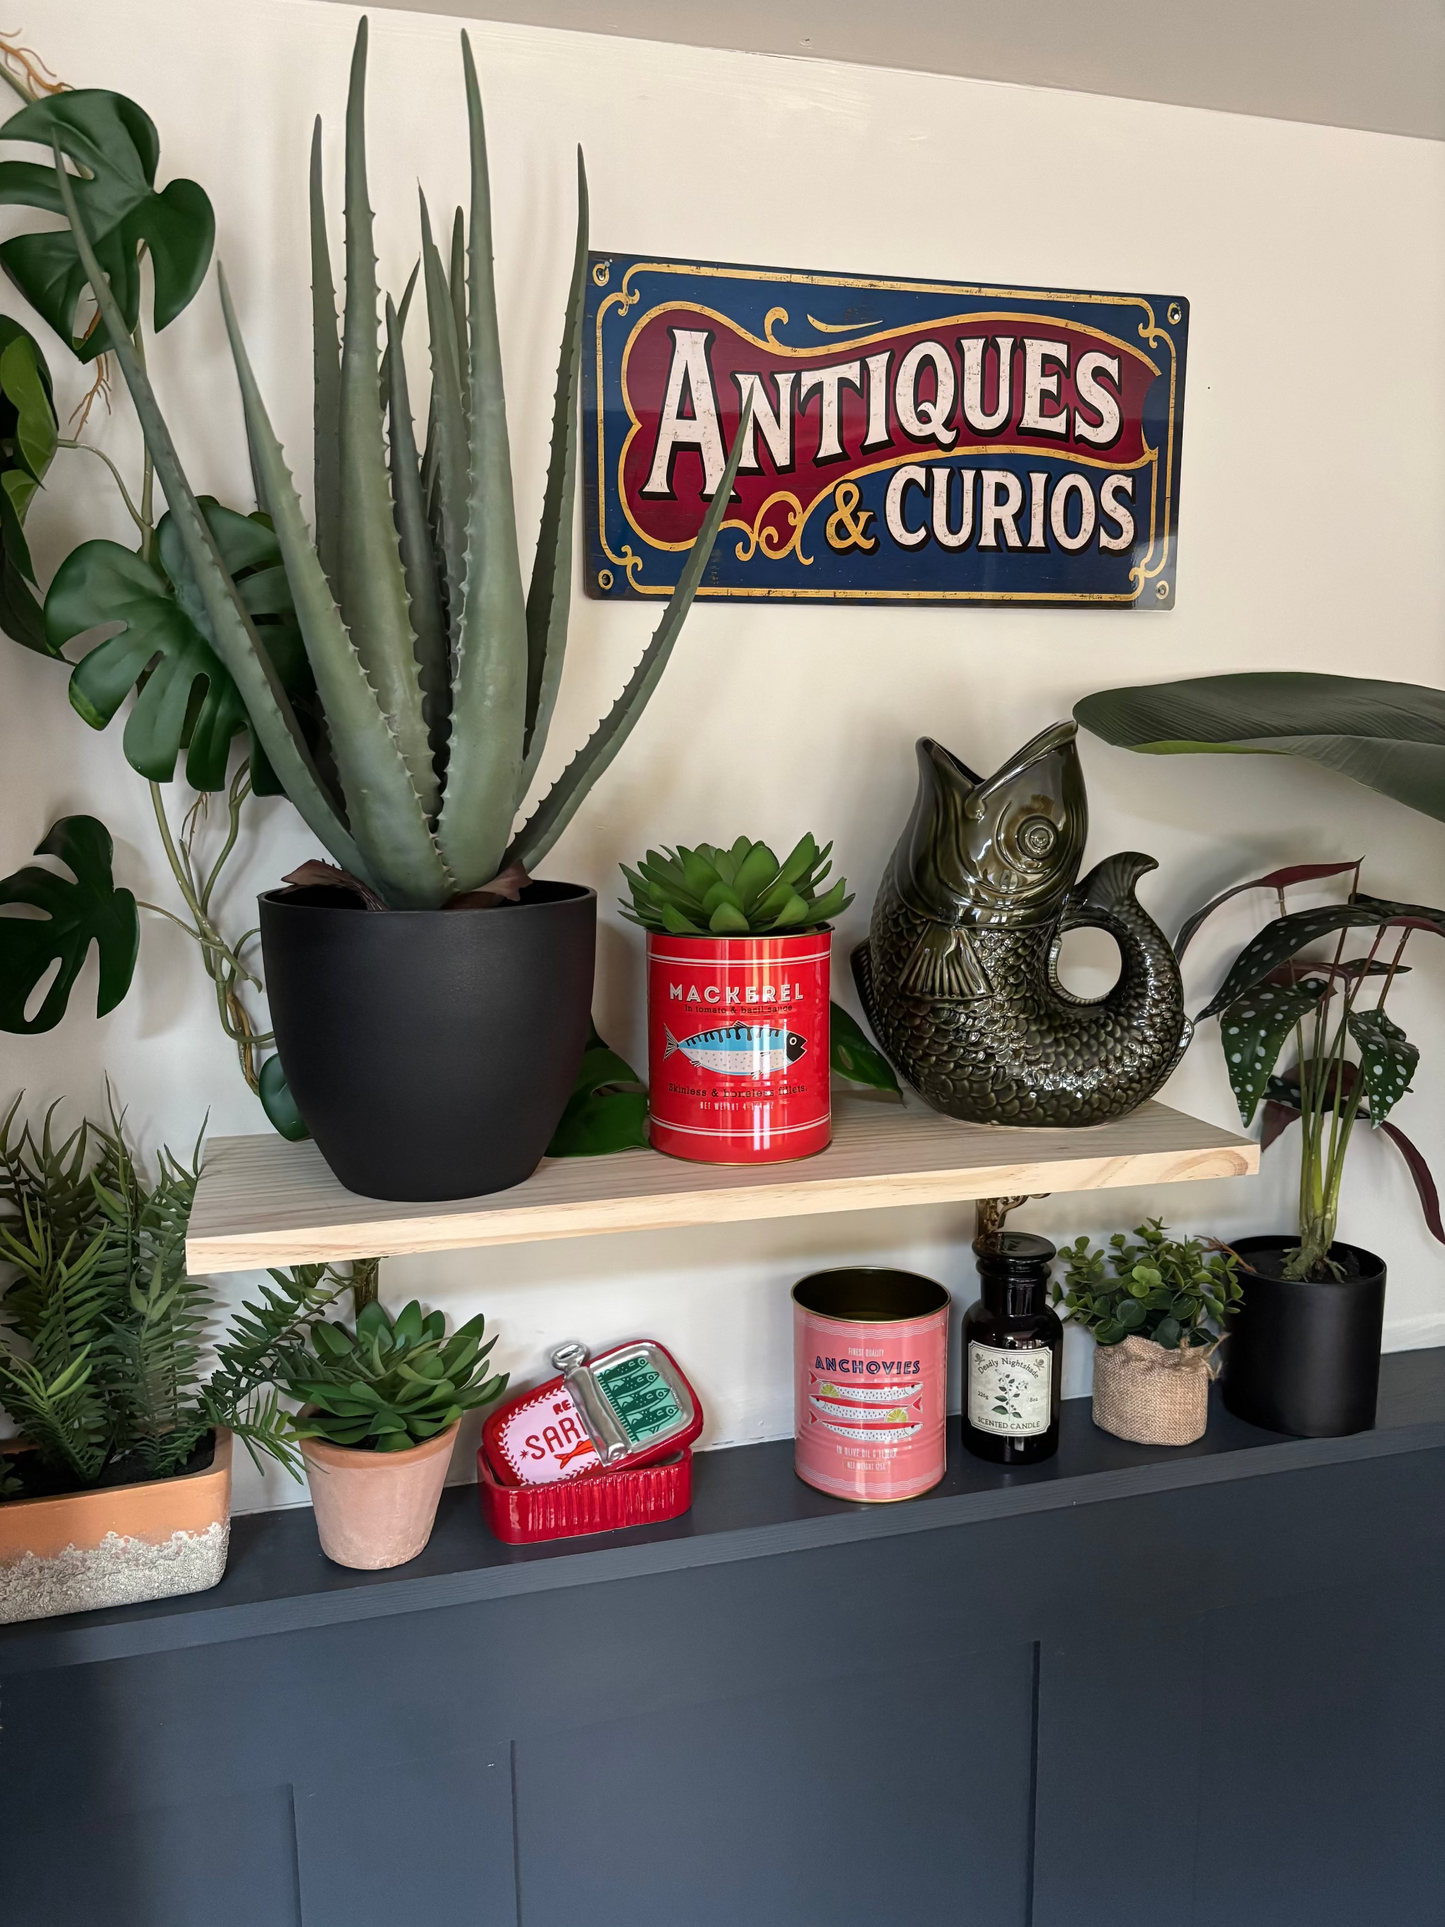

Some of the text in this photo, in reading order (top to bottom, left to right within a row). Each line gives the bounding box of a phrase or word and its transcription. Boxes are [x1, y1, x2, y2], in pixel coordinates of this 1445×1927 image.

[642, 328, 1121, 498] ANTIQUES
[826, 464, 1135, 551] & CURIOS
[670, 982, 804, 1004] MACKEREL
[684, 1004, 792, 1014] In tomato & basil sauce
[668, 1083, 808, 1098] Skinless & boneless fillets.
[700, 1101, 711, 1110] NET
[714, 1101, 739, 1111] WEIGHT
[848, 1347, 884, 1358] FINEST QUALITY
[815, 1356, 921, 1375] ANCHOVIES
[978, 1357, 1039, 1379] Deadly Nightshade
[552, 1399, 576, 1416] RE
[977, 1416, 1041, 1430] SCENTED CANDLE
[836, 1445, 842, 1455] IN
[844, 1447, 860, 1457] OLIVE
[861, 1448, 870, 1458] OIL
